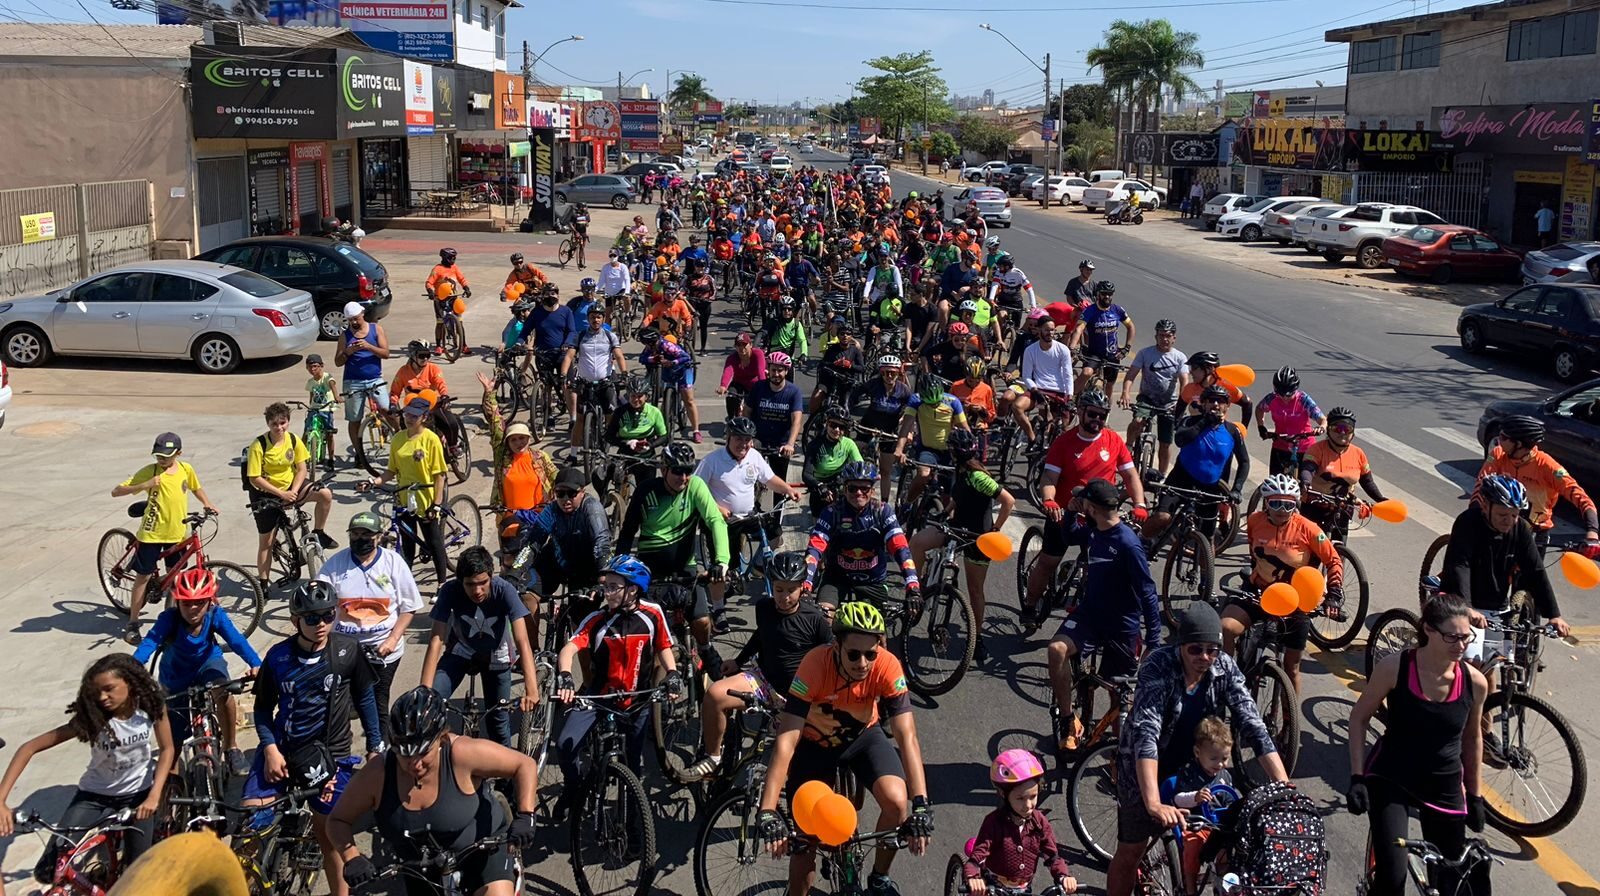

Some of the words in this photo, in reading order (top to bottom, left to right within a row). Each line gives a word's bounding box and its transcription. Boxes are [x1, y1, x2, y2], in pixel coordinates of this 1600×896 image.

[343, 5, 374, 17] CLÍNICA
[376, 7, 428, 17] VETERINÁRIA
[428, 8, 445, 18] 24H
[223, 68, 282, 76] BRITOS
[286, 70, 324, 78] CELL
[352, 74, 381, 90] BRITOS
[383, 76, 401, 91] CELL
[225, 106, 314, 115] @britoscellassistencia
[245, 117, 298, 125] 99450-8795
[1444, 110, 1506, 146] Safira
[580, 128, 618, 138] Bifão
[294, 144, 322, 158] havaianas
[1268, 152, 1296, 166] EMPÓRIO
[536, 134, 551, 208] SUBWAY
[250, 176, 258, 234] XEROX
[25, 219, 36, 228] USO
[838, 554, 857, 570] Red
[858, 555, 878, 570] Bull
[335, 624, 357, 634] DEUS
[307, 771, 330, 787] adidas
